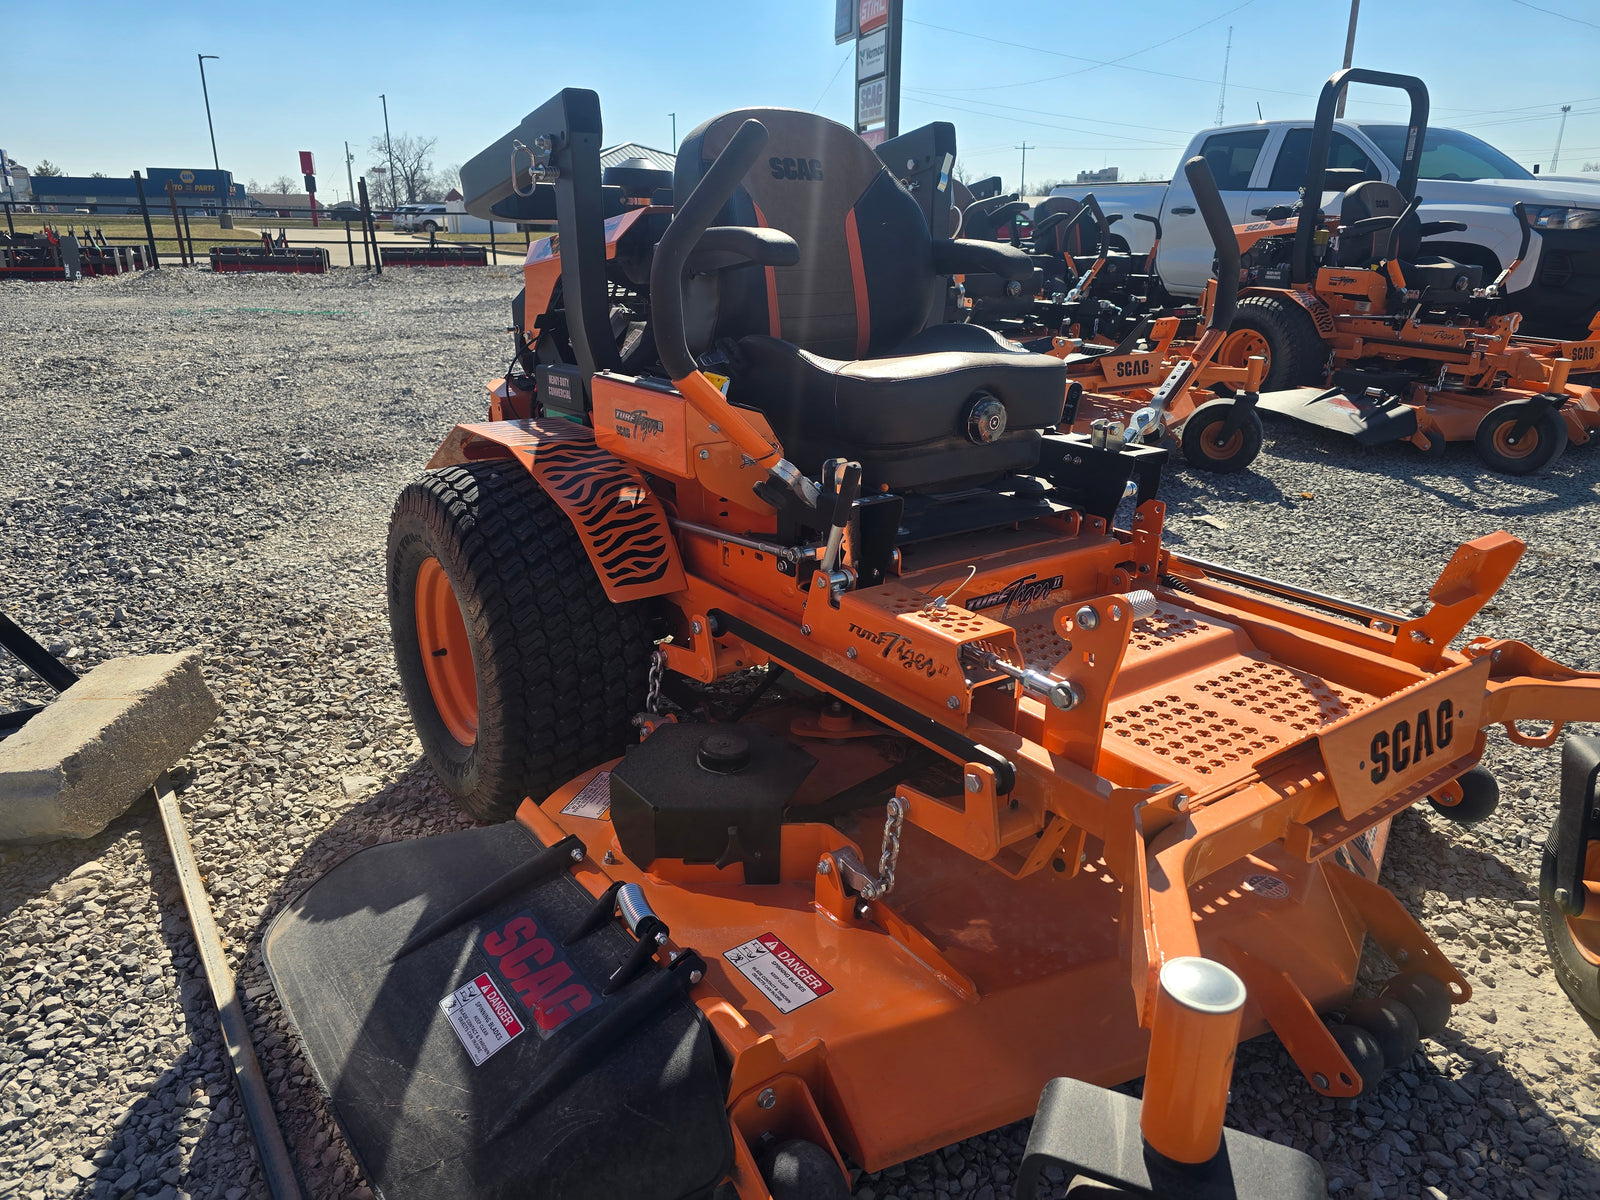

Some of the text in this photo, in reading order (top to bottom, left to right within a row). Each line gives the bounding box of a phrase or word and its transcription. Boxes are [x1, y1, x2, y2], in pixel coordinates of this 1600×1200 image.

[860, 82, 883, 110] SCAG
[769, 157, 824, 181] SCAG
[194, 184, 215, 192] PARTS
[1244, 222, 1272, 233] SCAG
[1572, 346, 1595, 361] SCAG
[1117, 360, 1149, 377] SCAG
[615, 409, 637, 421] TURF
[616, 424, 631, 438] SCAG
[967, 590, 1009, 611] TURF
[848, 622, 888, 646] TURF
[1370, 698, 1454, 785] SCAG
[483, 916, 593, 1031] SCAG
[771, 960, 806, 992] SPINNING BLADES
[777, 951, 823, 989] DANGER
[486, 990, 515, 1026] DANGER
[473, 1015, 489, 1036] KEEP CLEAR
[474, 1001, 504, 1041] SPINNING BLADES
